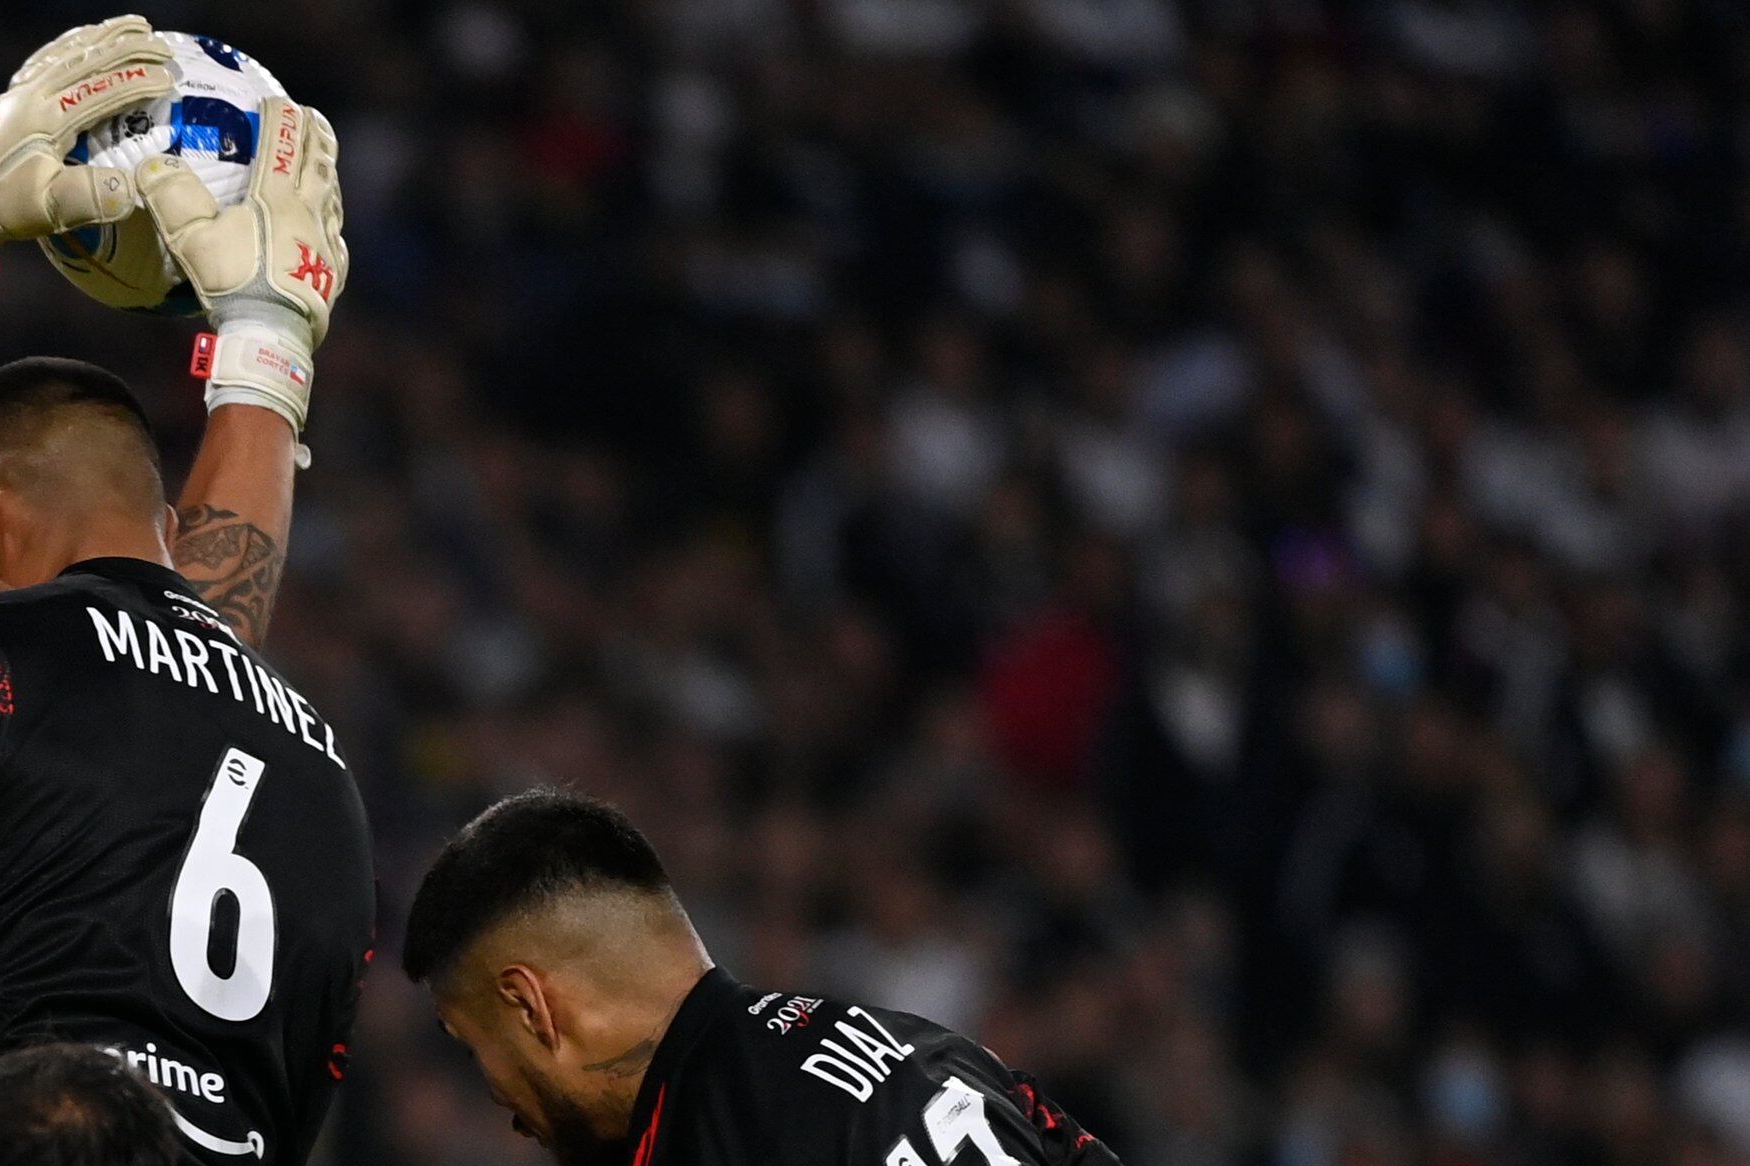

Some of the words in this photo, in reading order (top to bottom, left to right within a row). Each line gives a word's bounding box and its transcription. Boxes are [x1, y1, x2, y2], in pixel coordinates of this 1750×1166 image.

[170, 747, 276, 1022] 6
[102, 1042, 225, 1104] rime
[800, 1005, 916, 1103] DIAZ
